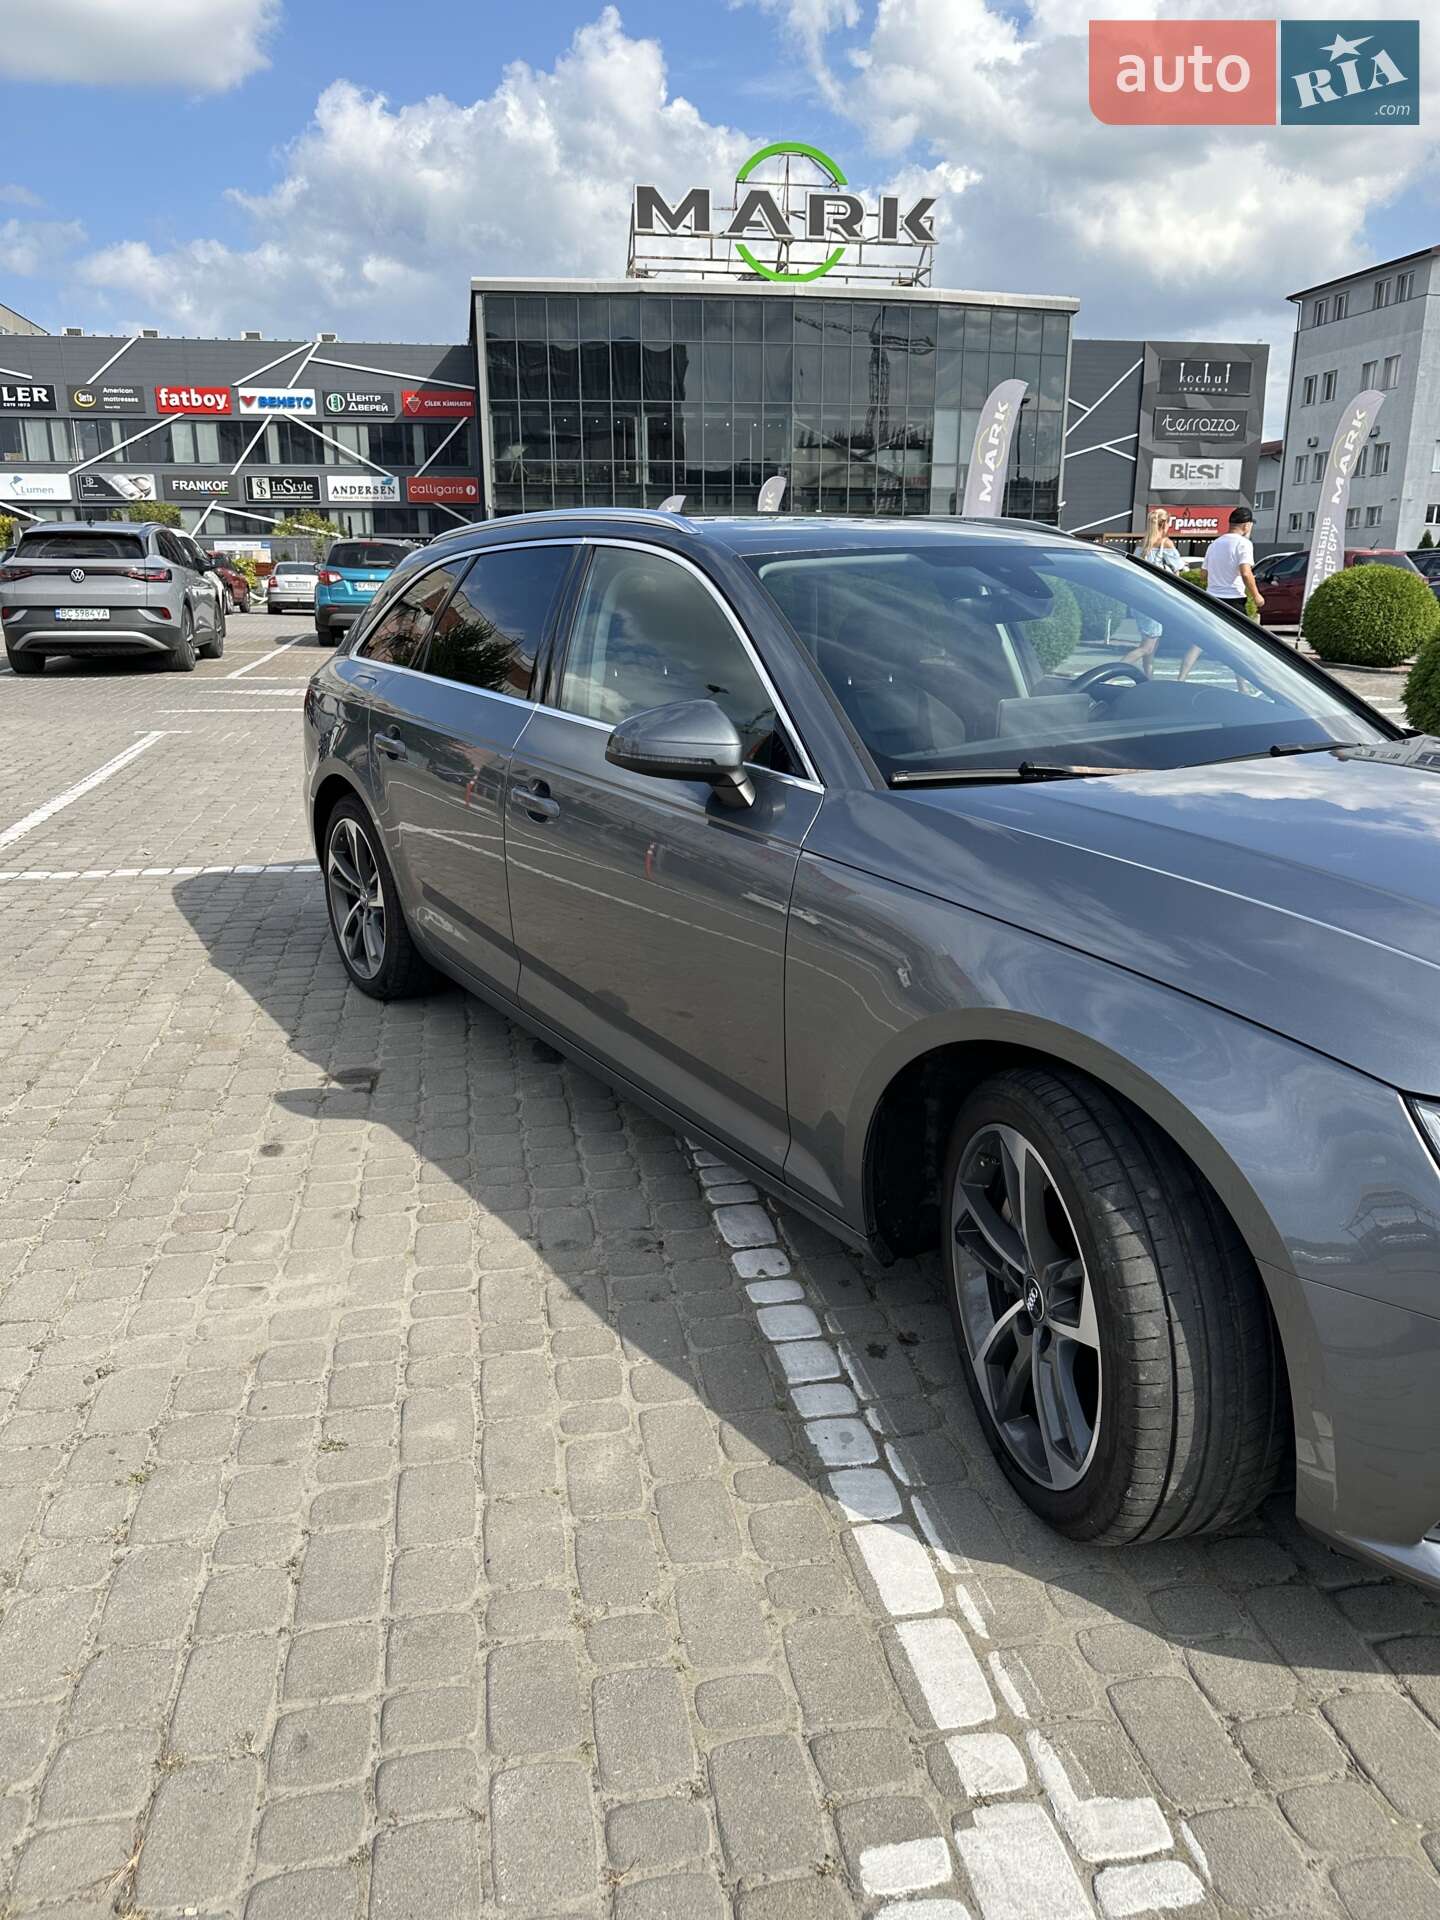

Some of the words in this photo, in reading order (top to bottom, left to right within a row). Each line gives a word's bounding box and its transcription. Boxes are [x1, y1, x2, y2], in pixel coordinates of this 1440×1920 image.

[633, 184, 940, 245] MARK
[978, 399, 1009, 502] MARK
[1331, 409, 1367, 505] MARK
[172, 480, 229, 491] FRANKOF
[331, 485, 396, 495] ANDERSEN
[410, 484, 464, 496] calligaris
